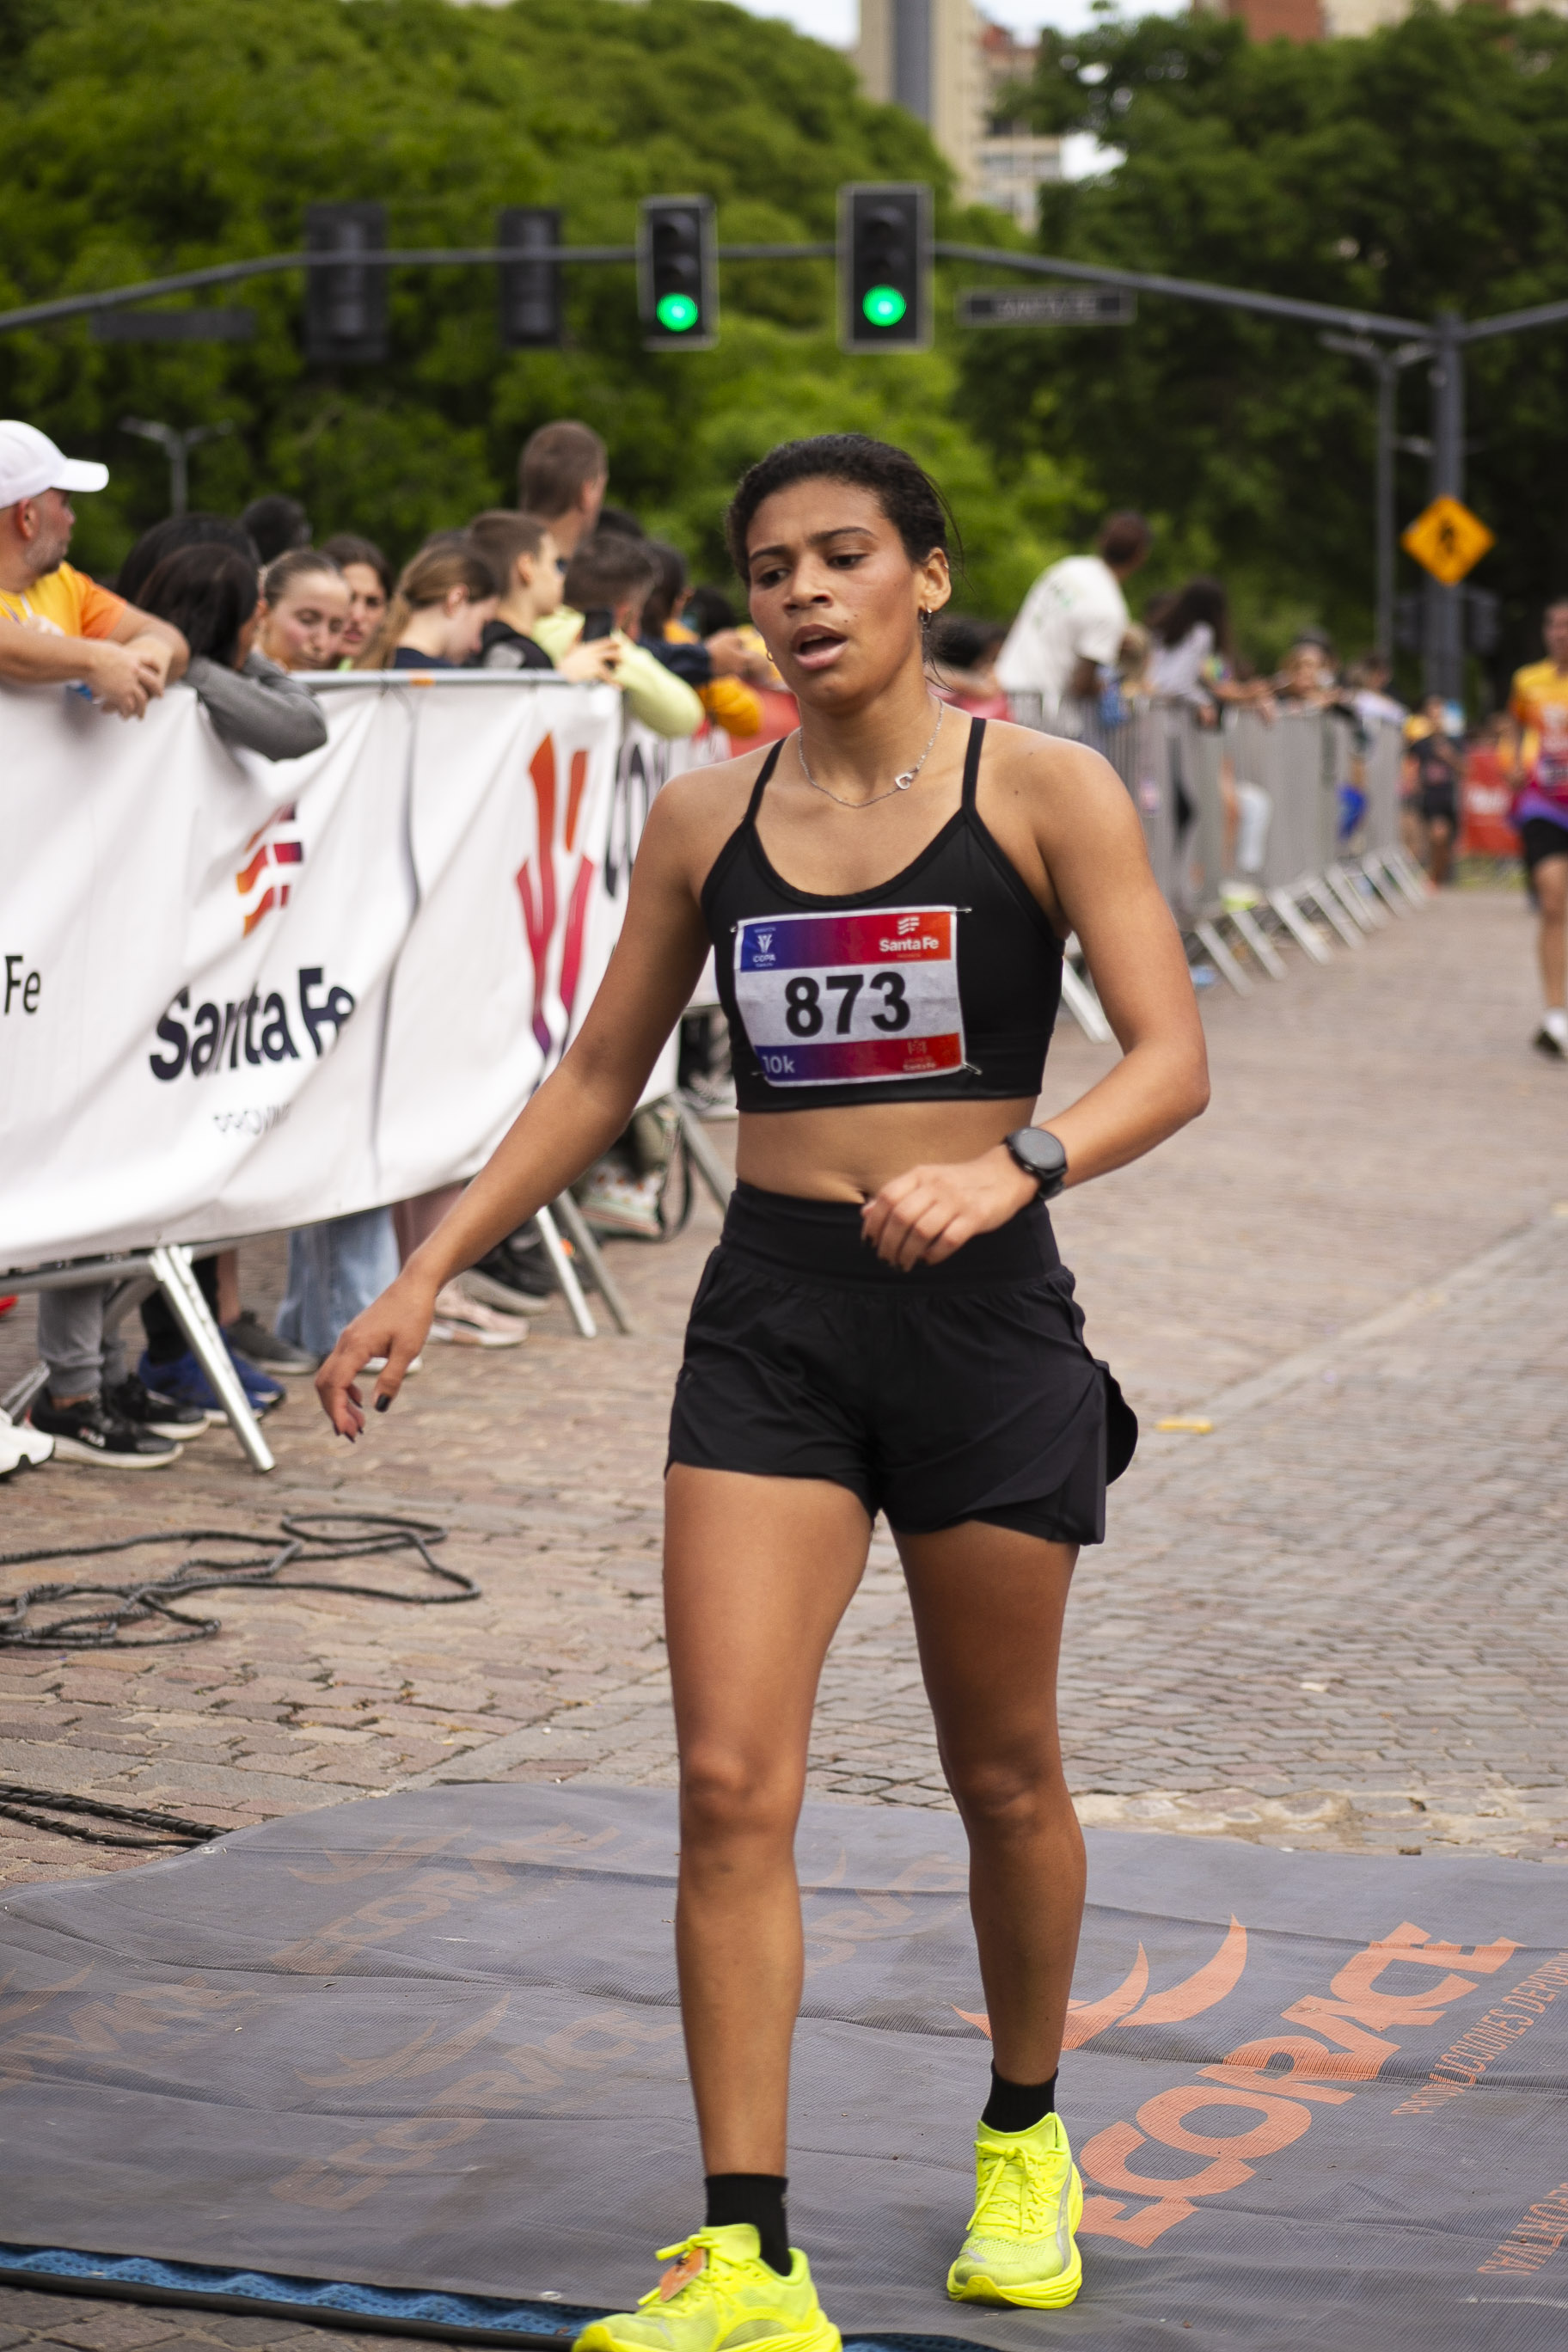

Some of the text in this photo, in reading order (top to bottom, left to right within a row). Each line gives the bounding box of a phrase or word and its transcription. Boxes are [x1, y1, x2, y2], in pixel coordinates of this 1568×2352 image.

[879, 936, 940, 952] Santa Fe
[4, 955, 40, 1014] Fe
[785, 971, 910, 1038] 873
[150, 985, 300, 1081] Santa
[762, 1055, 795, 1074] 10k
